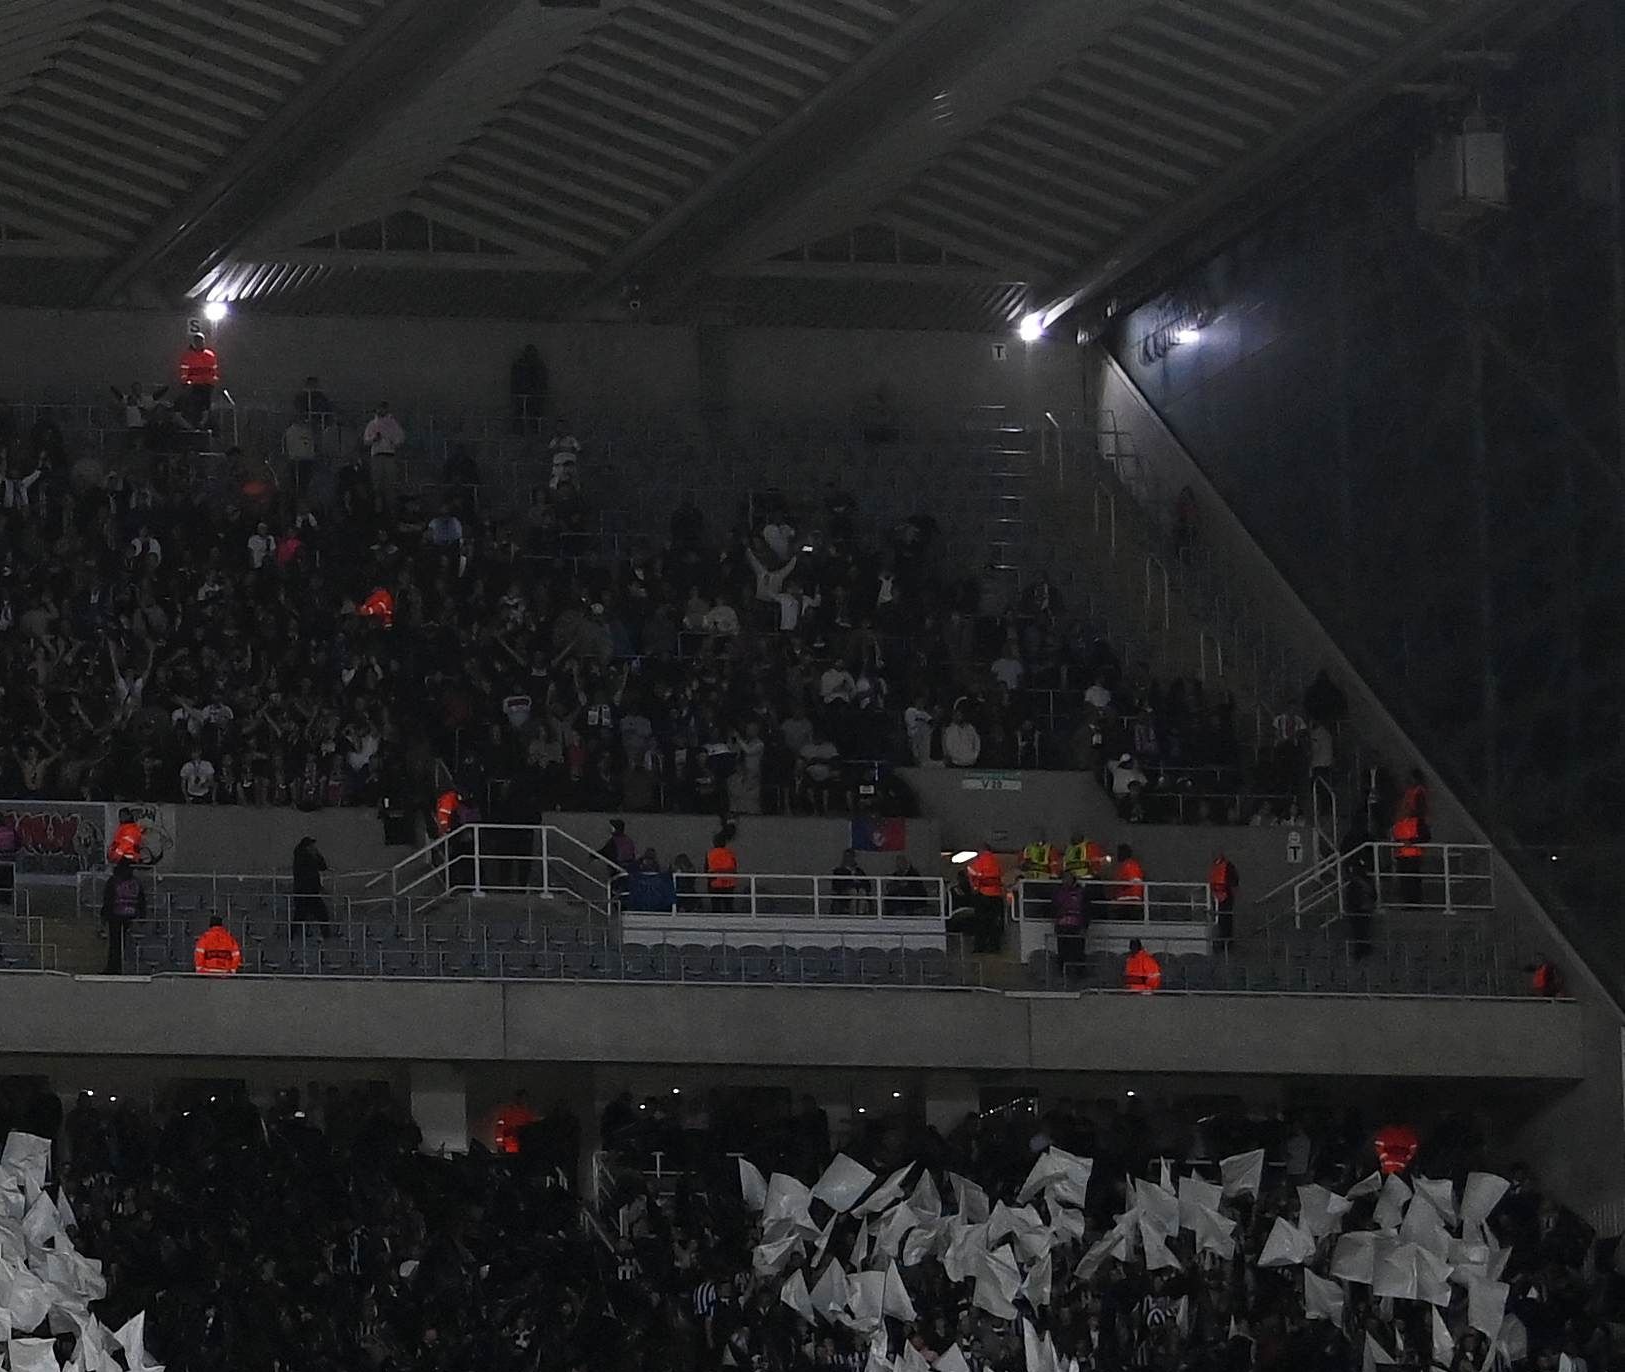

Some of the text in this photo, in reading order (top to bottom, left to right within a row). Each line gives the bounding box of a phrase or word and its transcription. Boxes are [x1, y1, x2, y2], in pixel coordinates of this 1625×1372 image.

[190, 319, 200, 332] S
[995, 346, 1005, 358] T
[1289, 846, 1300, 860] T
